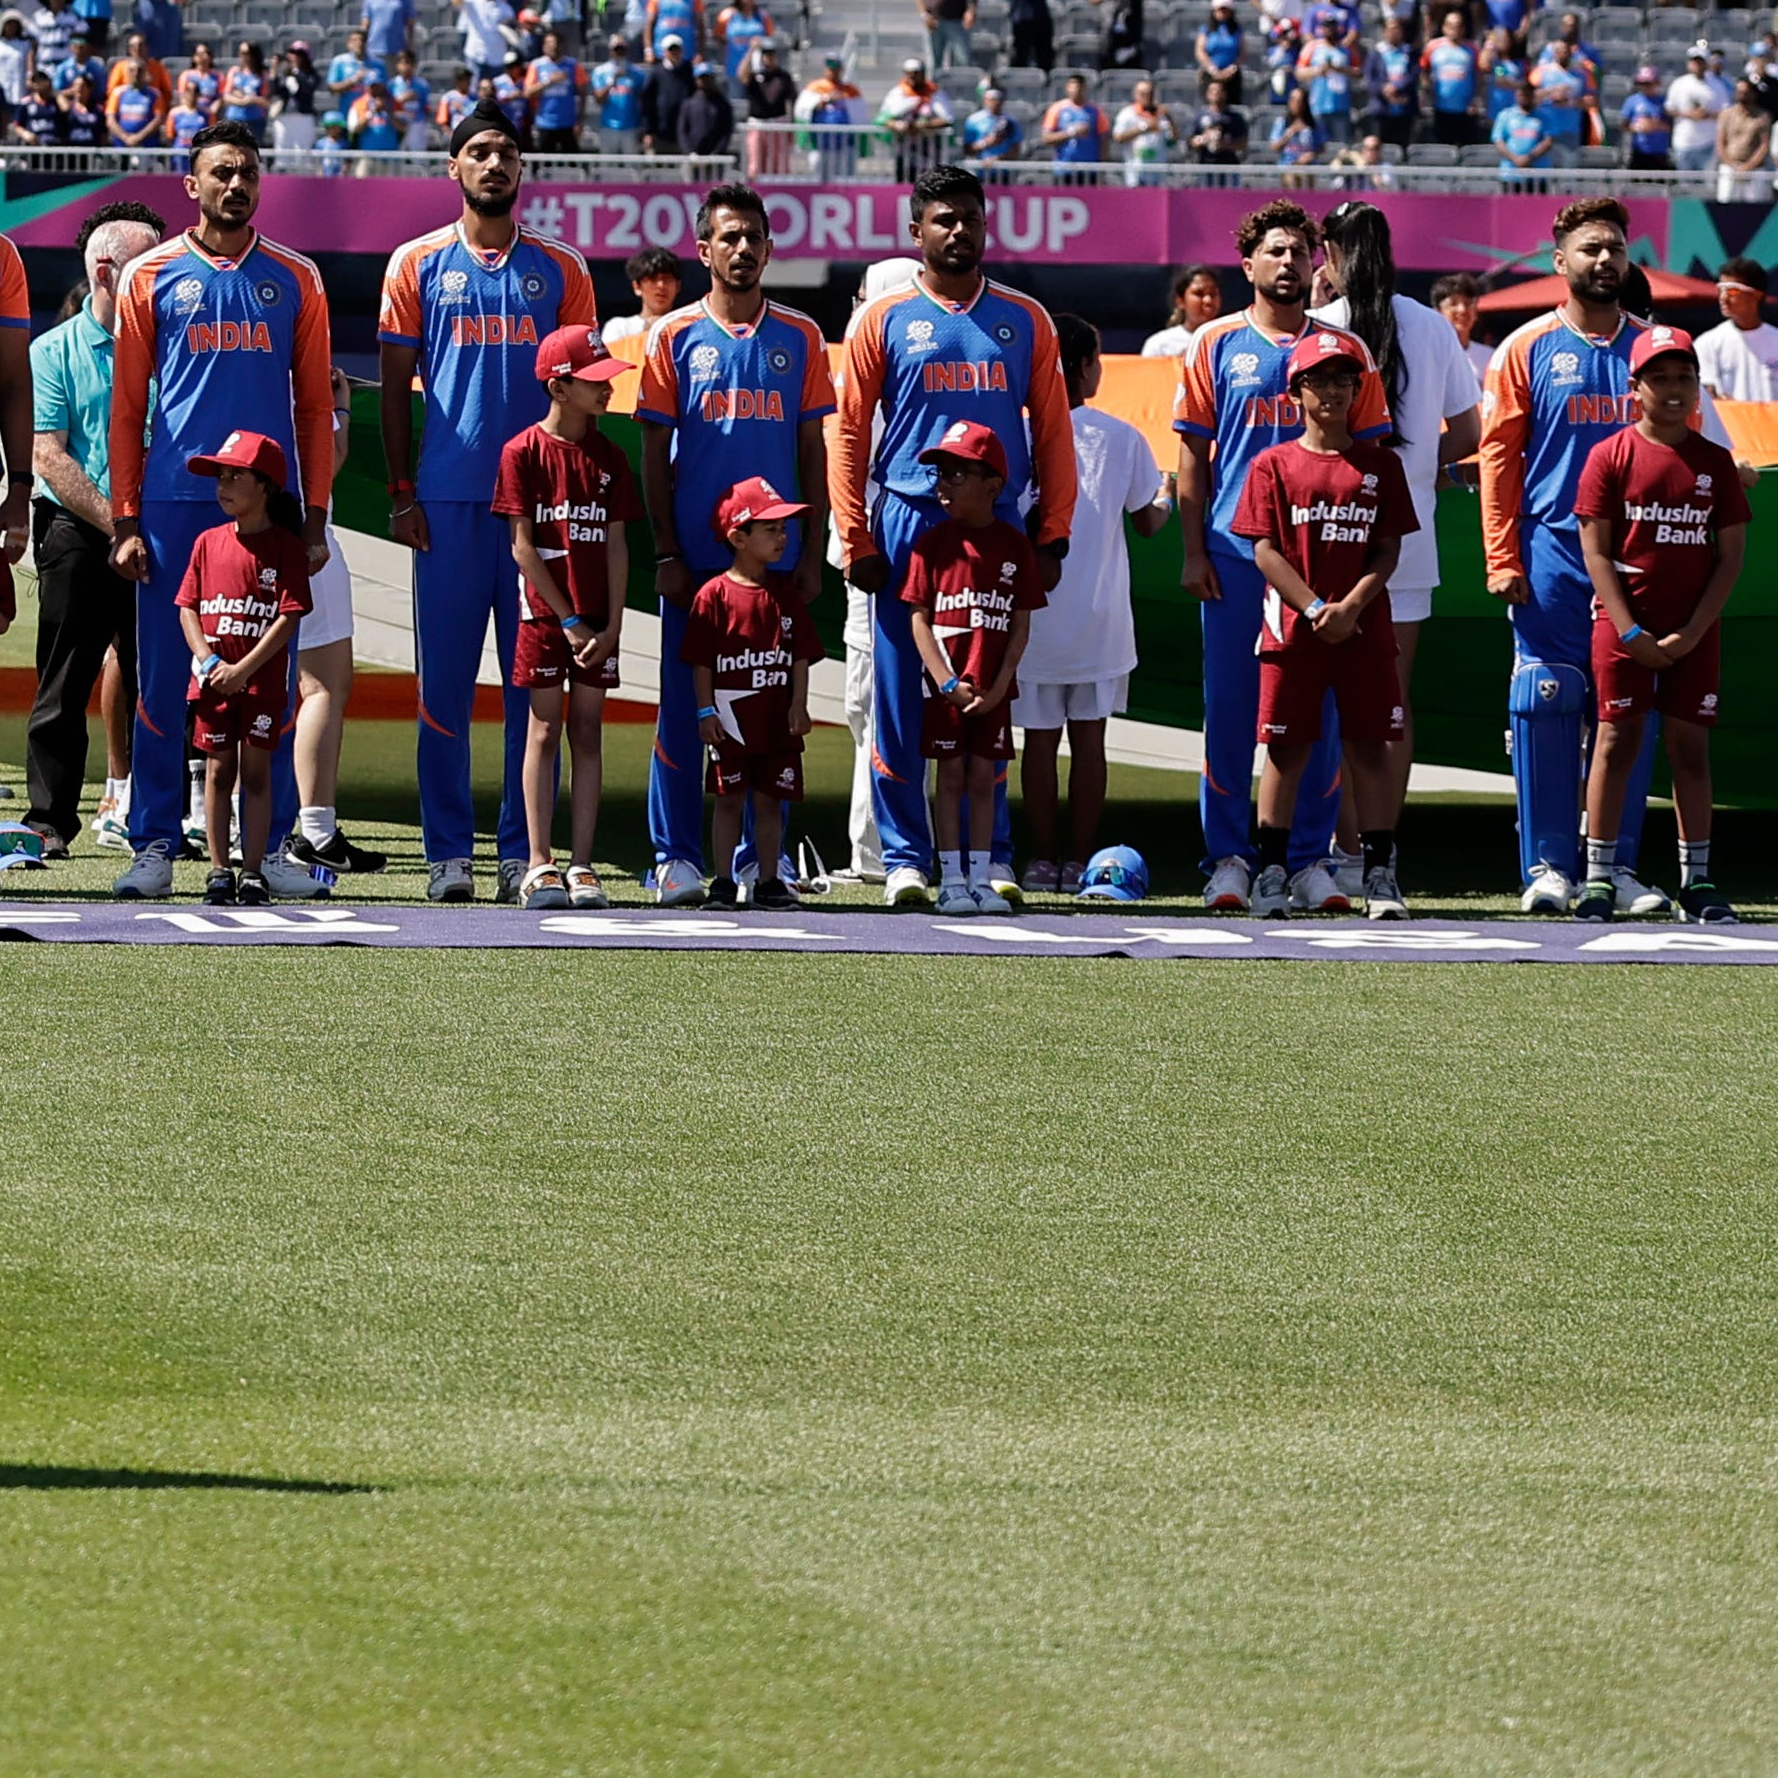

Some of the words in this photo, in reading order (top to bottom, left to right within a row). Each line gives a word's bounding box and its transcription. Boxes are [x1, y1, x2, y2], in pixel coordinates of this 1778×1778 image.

[521, 192, 1090, 250] #T20ORLUP
[186, 321, 272, 353] INDIA
[451, 314, 539, 346] INDIA
[922, 361, 1008, 392] INDIA
[700, 388, 785, 421] INDIA
[535, 500, 607, 524] IndusIn
[569, 522, 606, 543] Ban
[1655, 524, 1707, 545] Bank
[969, 608, 1012, 633] Bank
[752, 668, 788, 689] Ban
[930, 924, 1778, 952] USA
